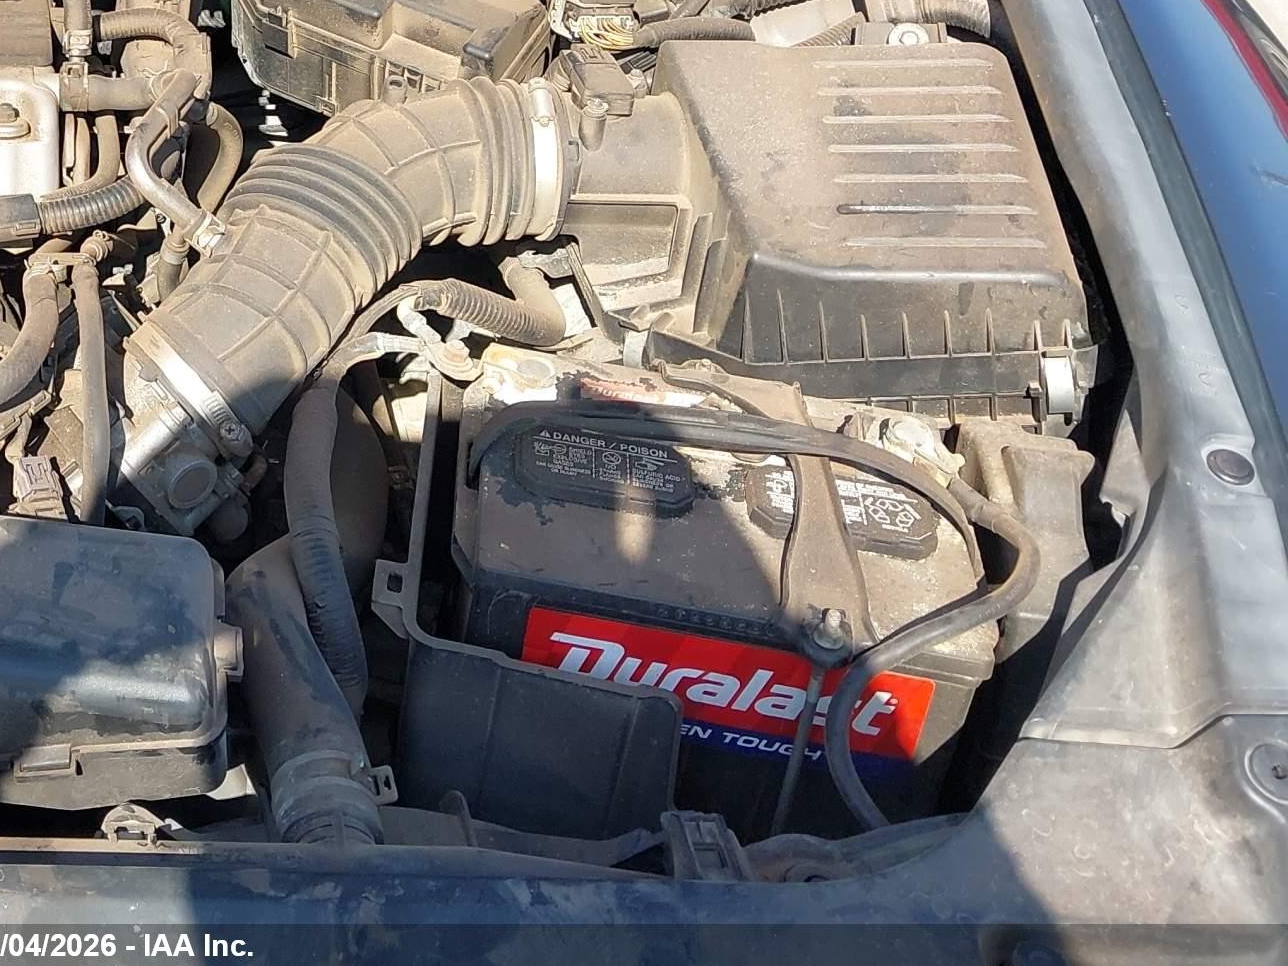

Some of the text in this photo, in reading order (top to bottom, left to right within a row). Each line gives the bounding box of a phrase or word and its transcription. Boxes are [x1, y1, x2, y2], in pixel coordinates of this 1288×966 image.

[553, 431, 606, 447] DANGER
[620, 443, 668, 459] POISON
[680, 723, 713, 739] EN
